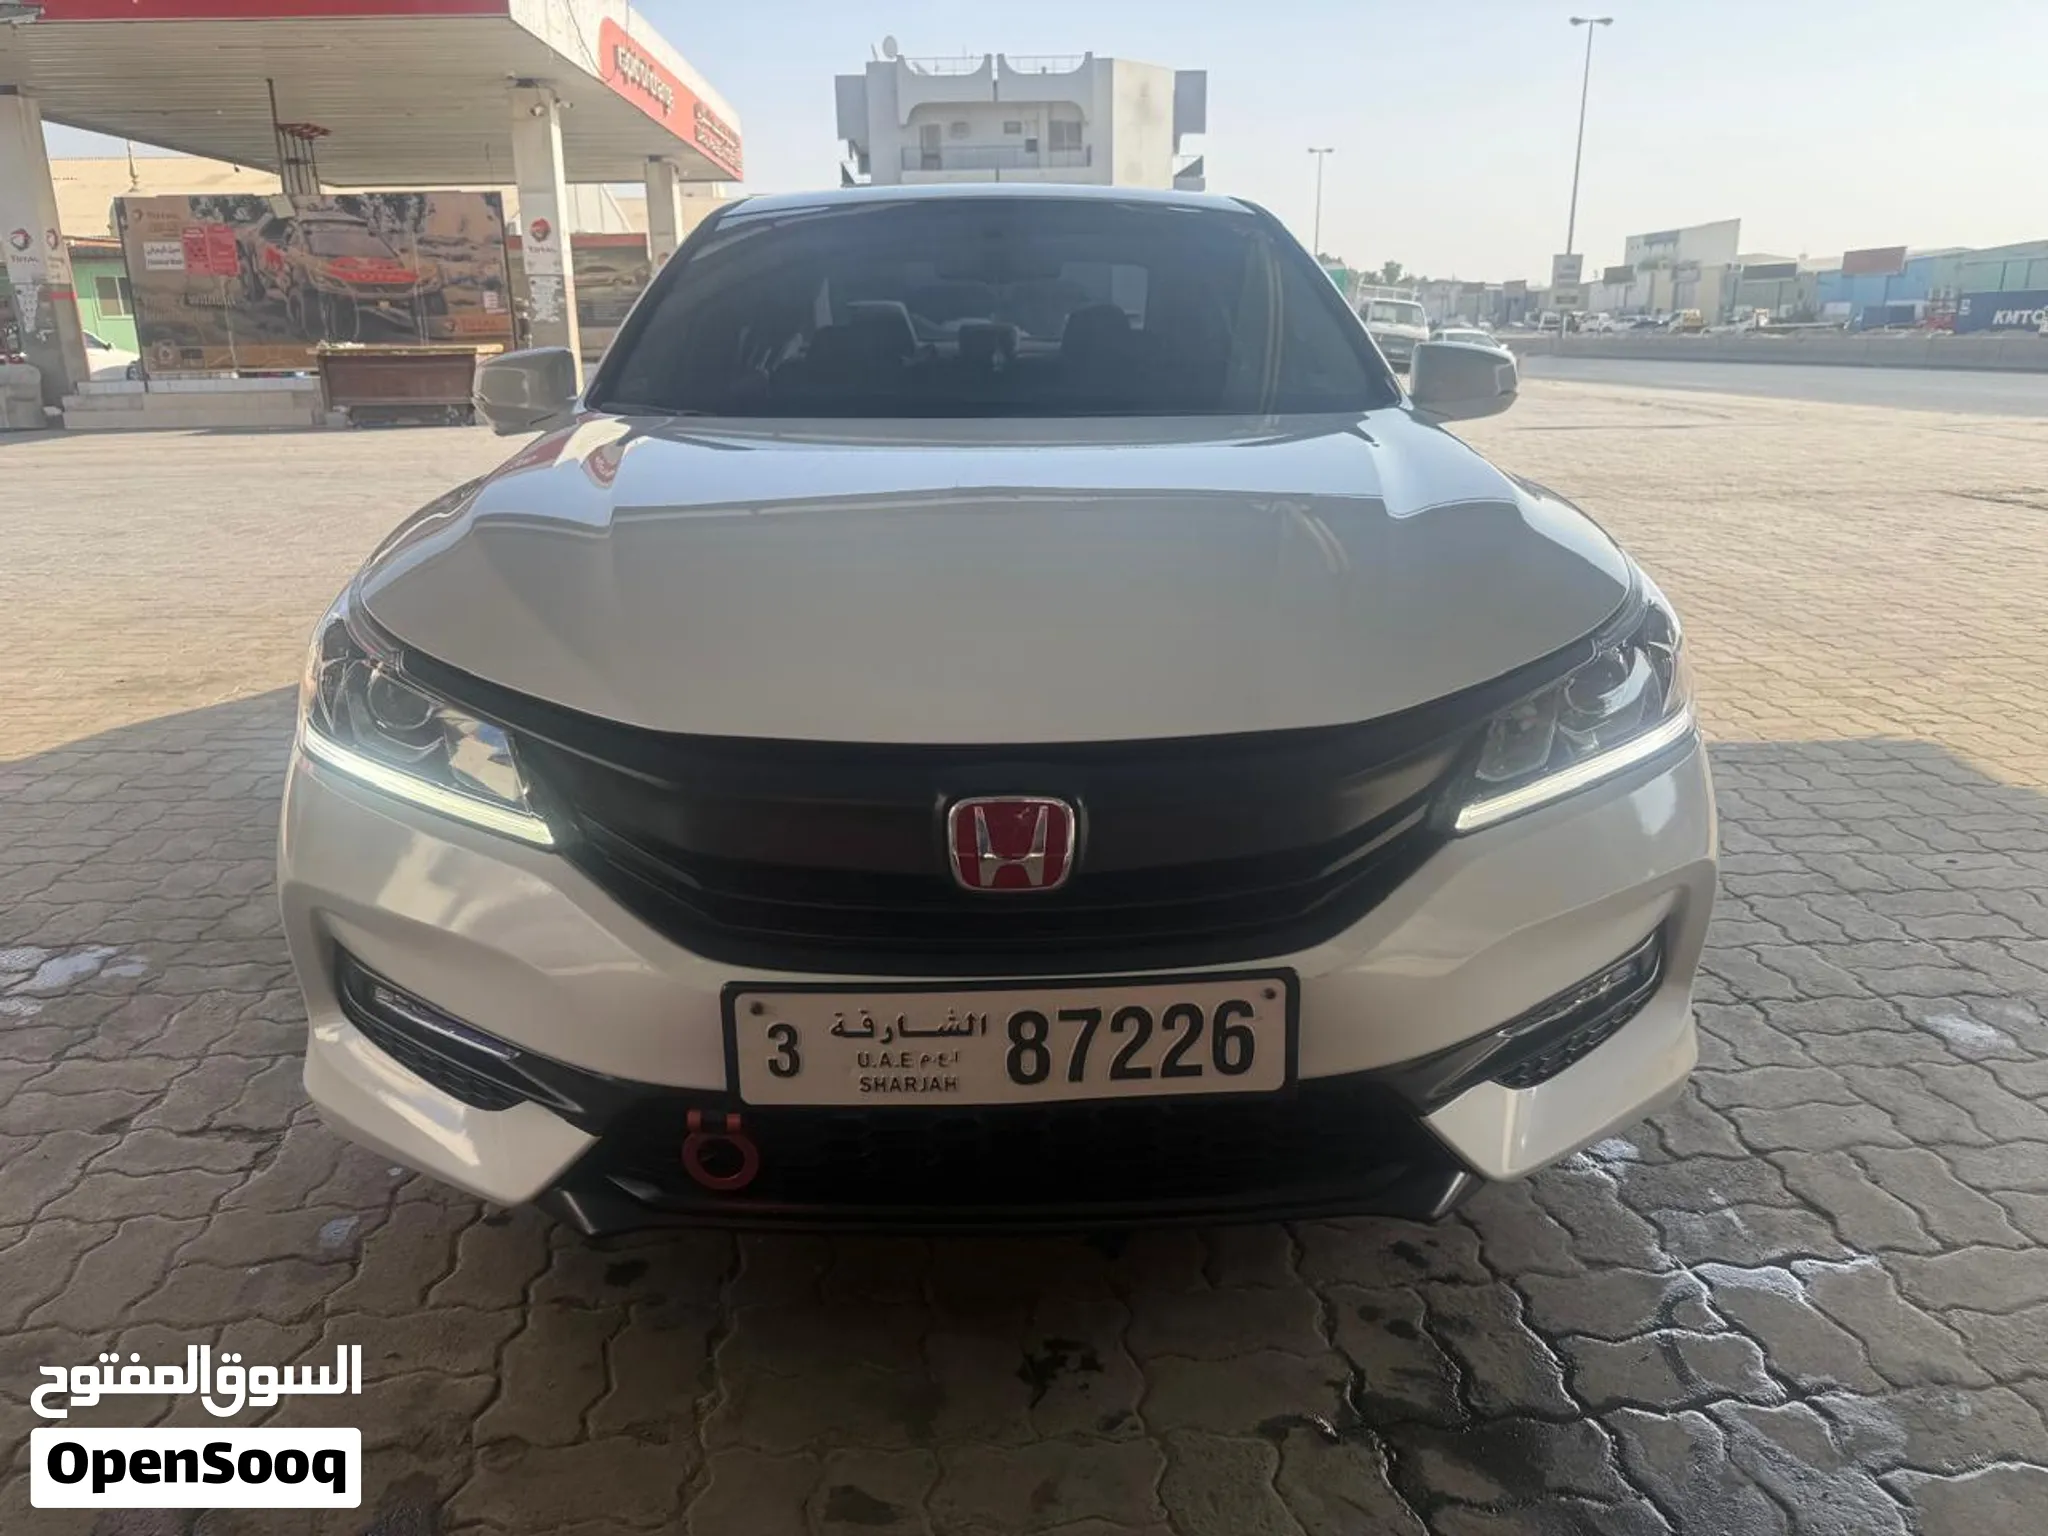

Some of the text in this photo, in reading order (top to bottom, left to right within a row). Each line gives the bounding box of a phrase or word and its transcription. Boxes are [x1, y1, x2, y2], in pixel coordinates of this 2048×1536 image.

[830, 1008, 988, 1045] الشارقة
[1006, 999, 1256, 1085] 87226
[767, 1023, 801, 1079] 3
[859, 1076, 957, 1093] SHARJAH
